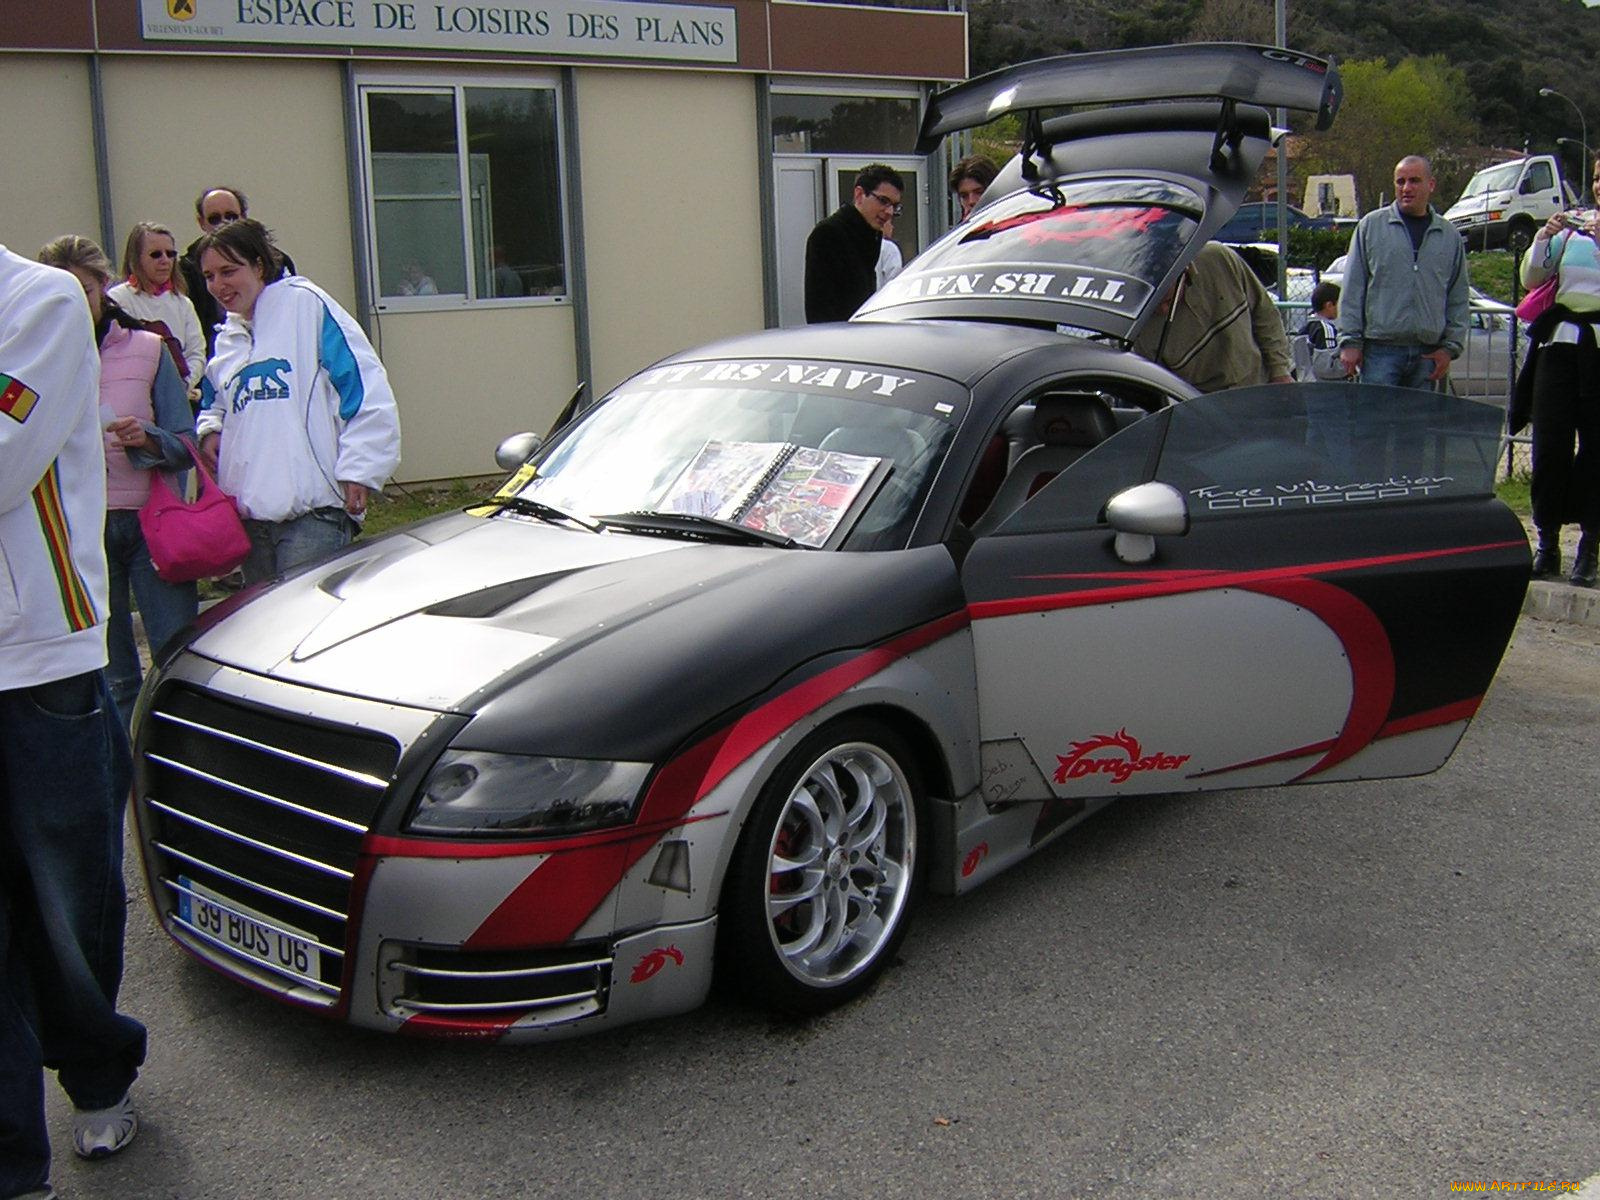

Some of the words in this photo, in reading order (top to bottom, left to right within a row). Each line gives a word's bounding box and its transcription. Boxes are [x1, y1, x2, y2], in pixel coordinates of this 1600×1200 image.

[236, 0, 356, 28] ESPACE
[373, 2, 417, 31] DE
[435, 6, 550, 36] LOISIRS
[567, 13, 619, 41] DES
[635, 17, 724, 46] PLANS
[990, 272, 1055, 295] RS
[1062, 275, 1126, 303] TT
[641, 364, 704, 385] TT
[700, 363, 771, 382] RS
[771, 364, 916, 397] NAVY
[1208, 485, 1441, 510] CONCEPT
[1060, 752, 1191, 784] Dragster
[197, 896, 222, 935] 39
[278, 932, 308, 973] 06
